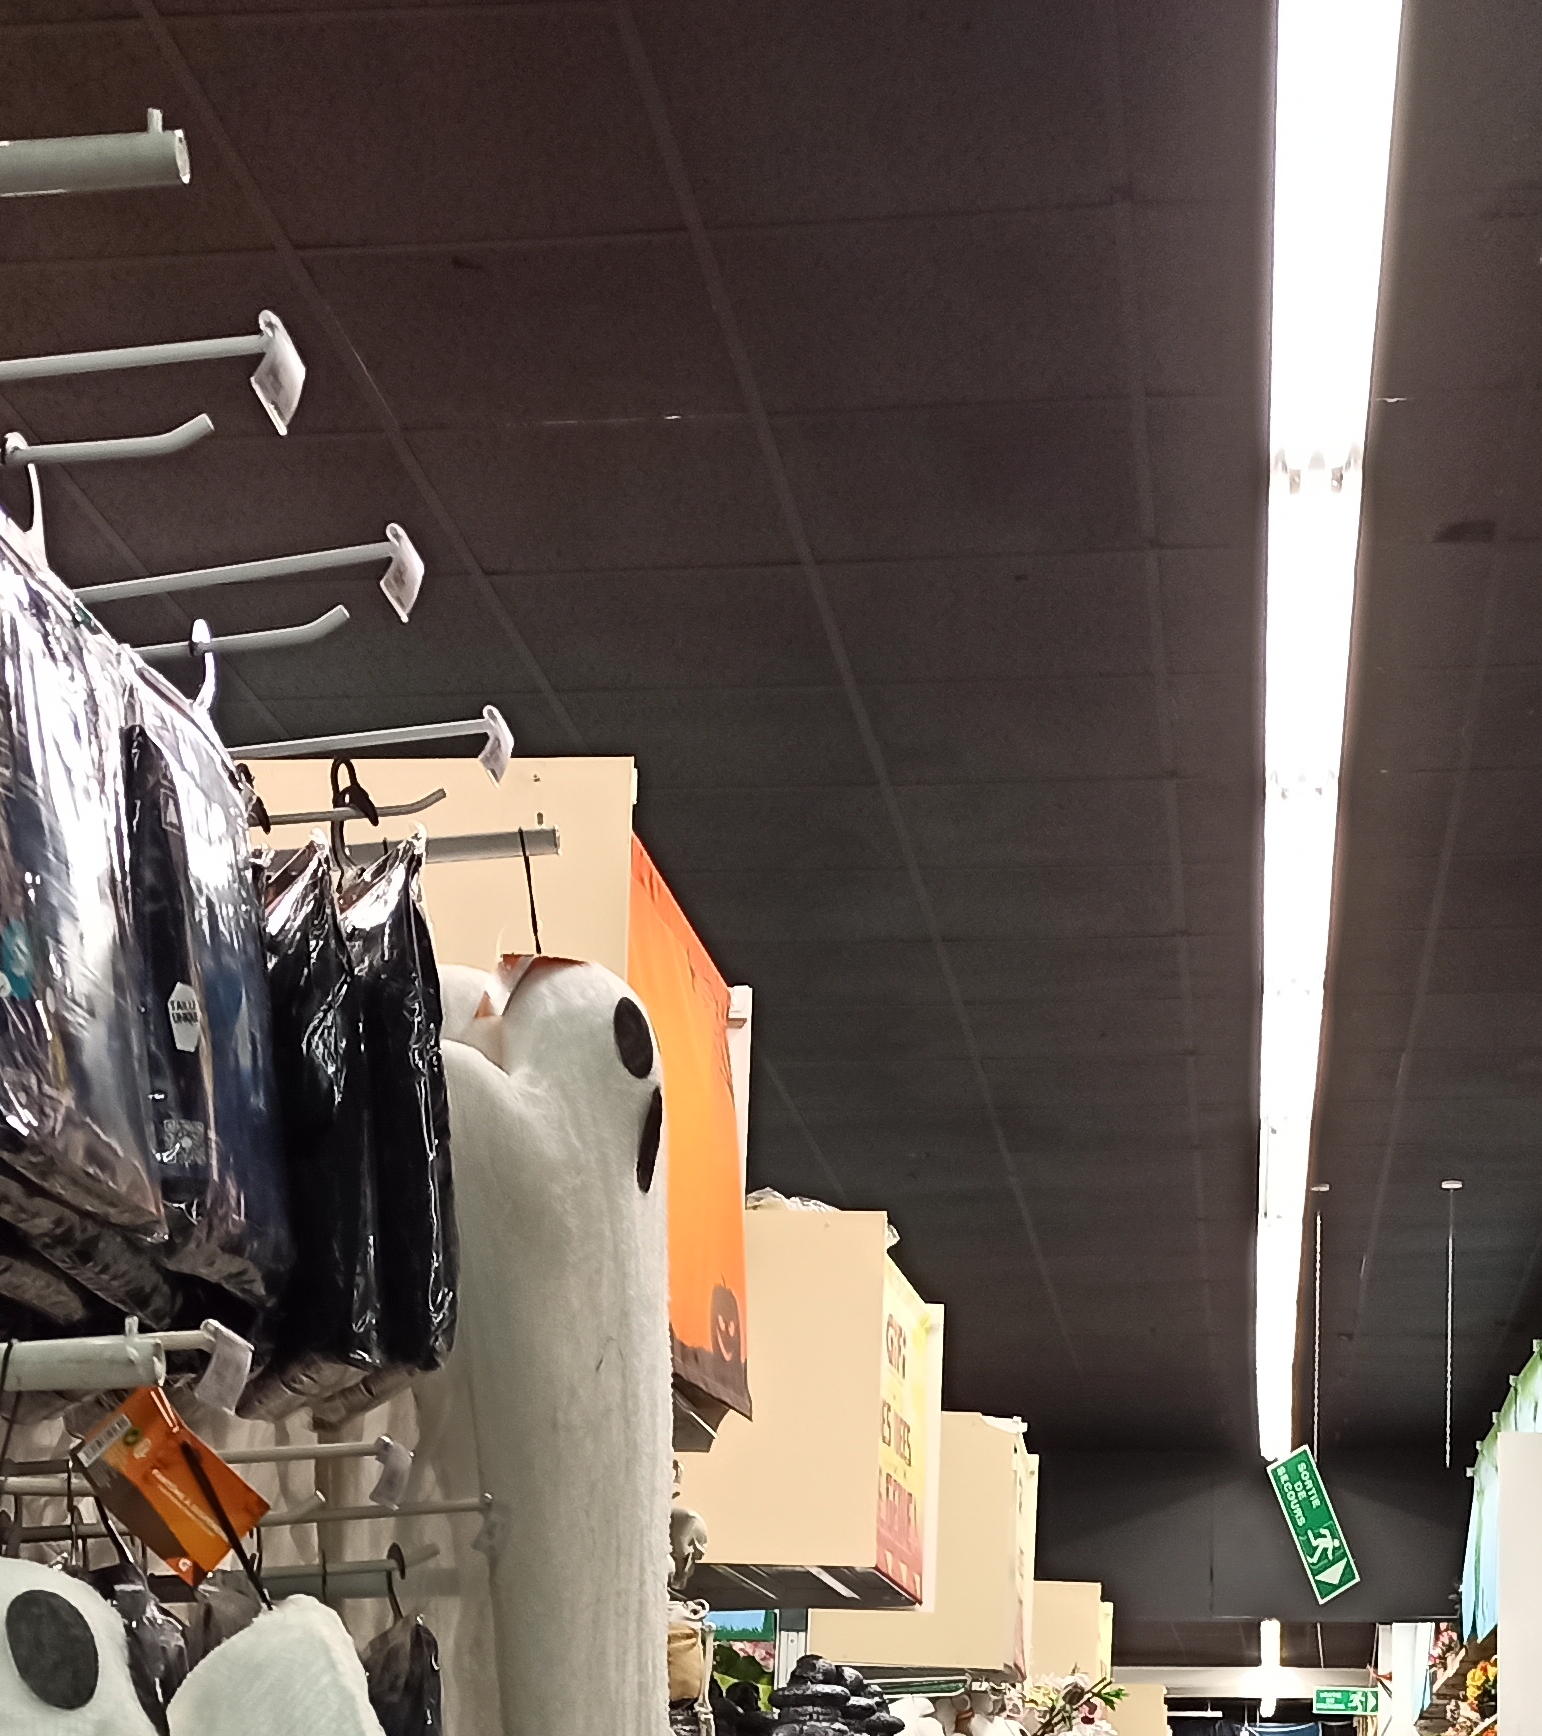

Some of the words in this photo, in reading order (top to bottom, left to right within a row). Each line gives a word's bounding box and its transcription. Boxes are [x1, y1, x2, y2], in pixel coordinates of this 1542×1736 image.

[1276, 1465, 1306, 1527] SECOURS
[1293, 1480, 1307, 1501] DE
[1298, 1462, 1321, 1509] SORTIE
